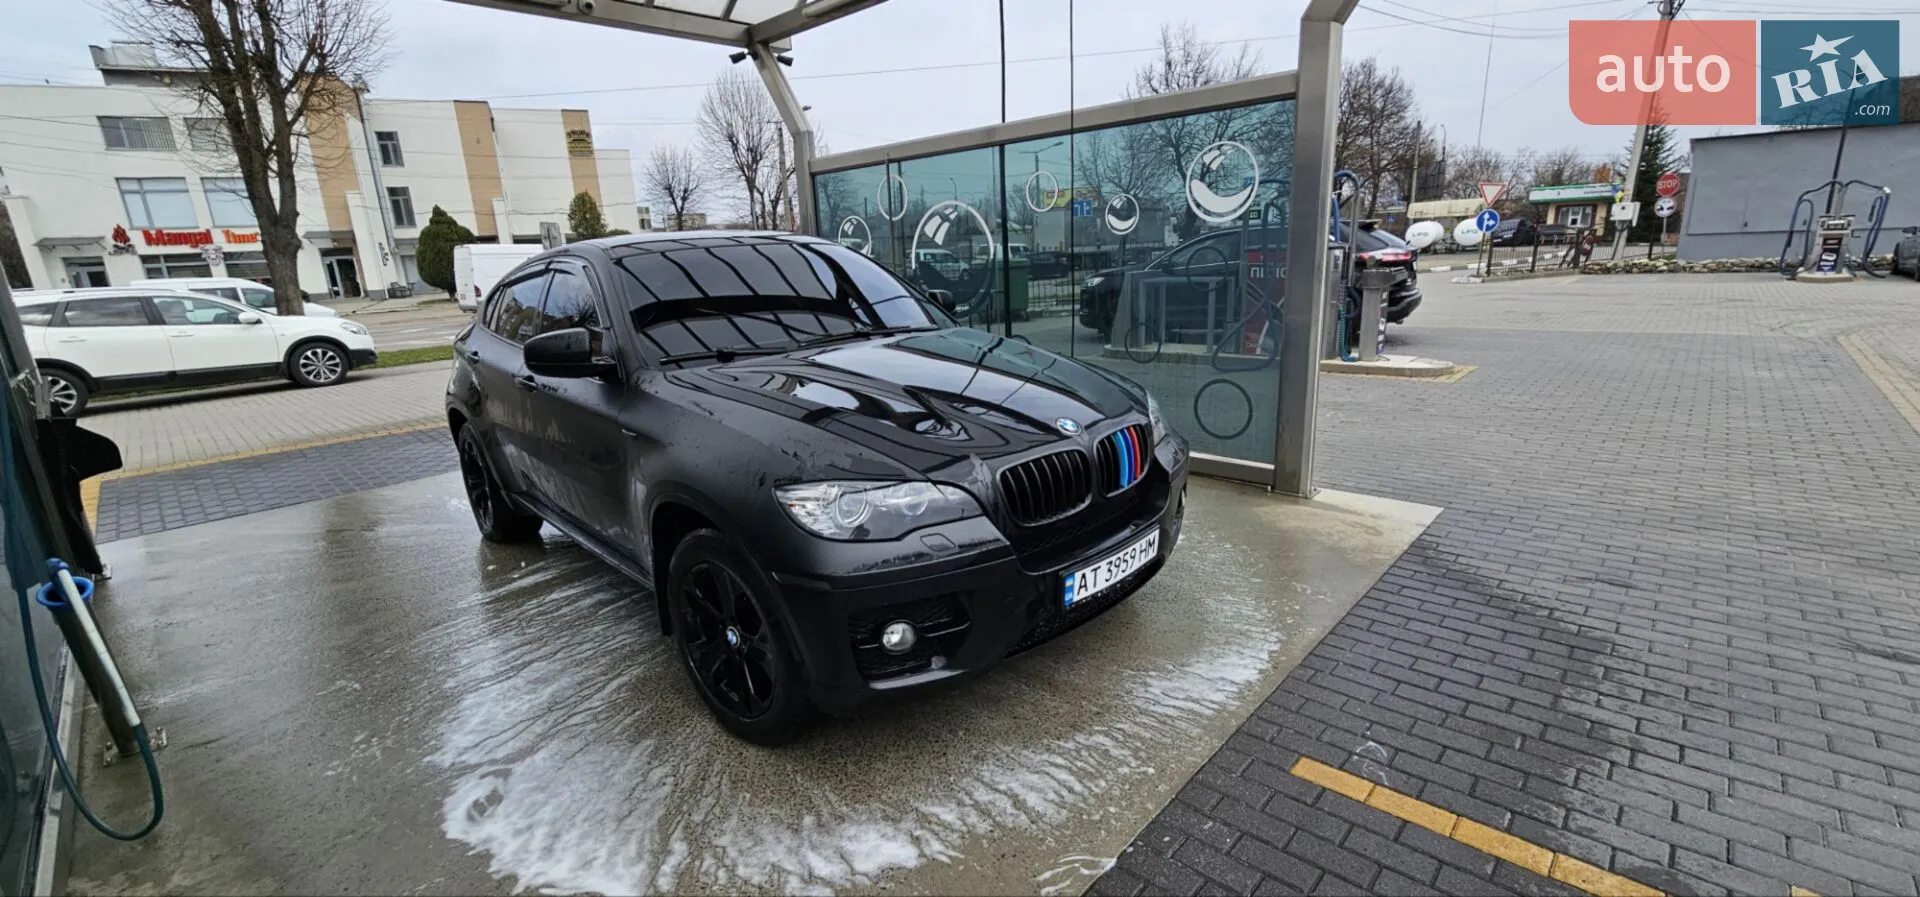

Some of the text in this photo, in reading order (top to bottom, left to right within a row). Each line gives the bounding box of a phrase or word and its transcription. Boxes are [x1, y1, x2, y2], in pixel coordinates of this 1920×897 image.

[1657, 179, 1678, 190] STOP
[142, 227, 214, 249] Mangal
[1077, 533, 1157, 596] AT 3959 HM
